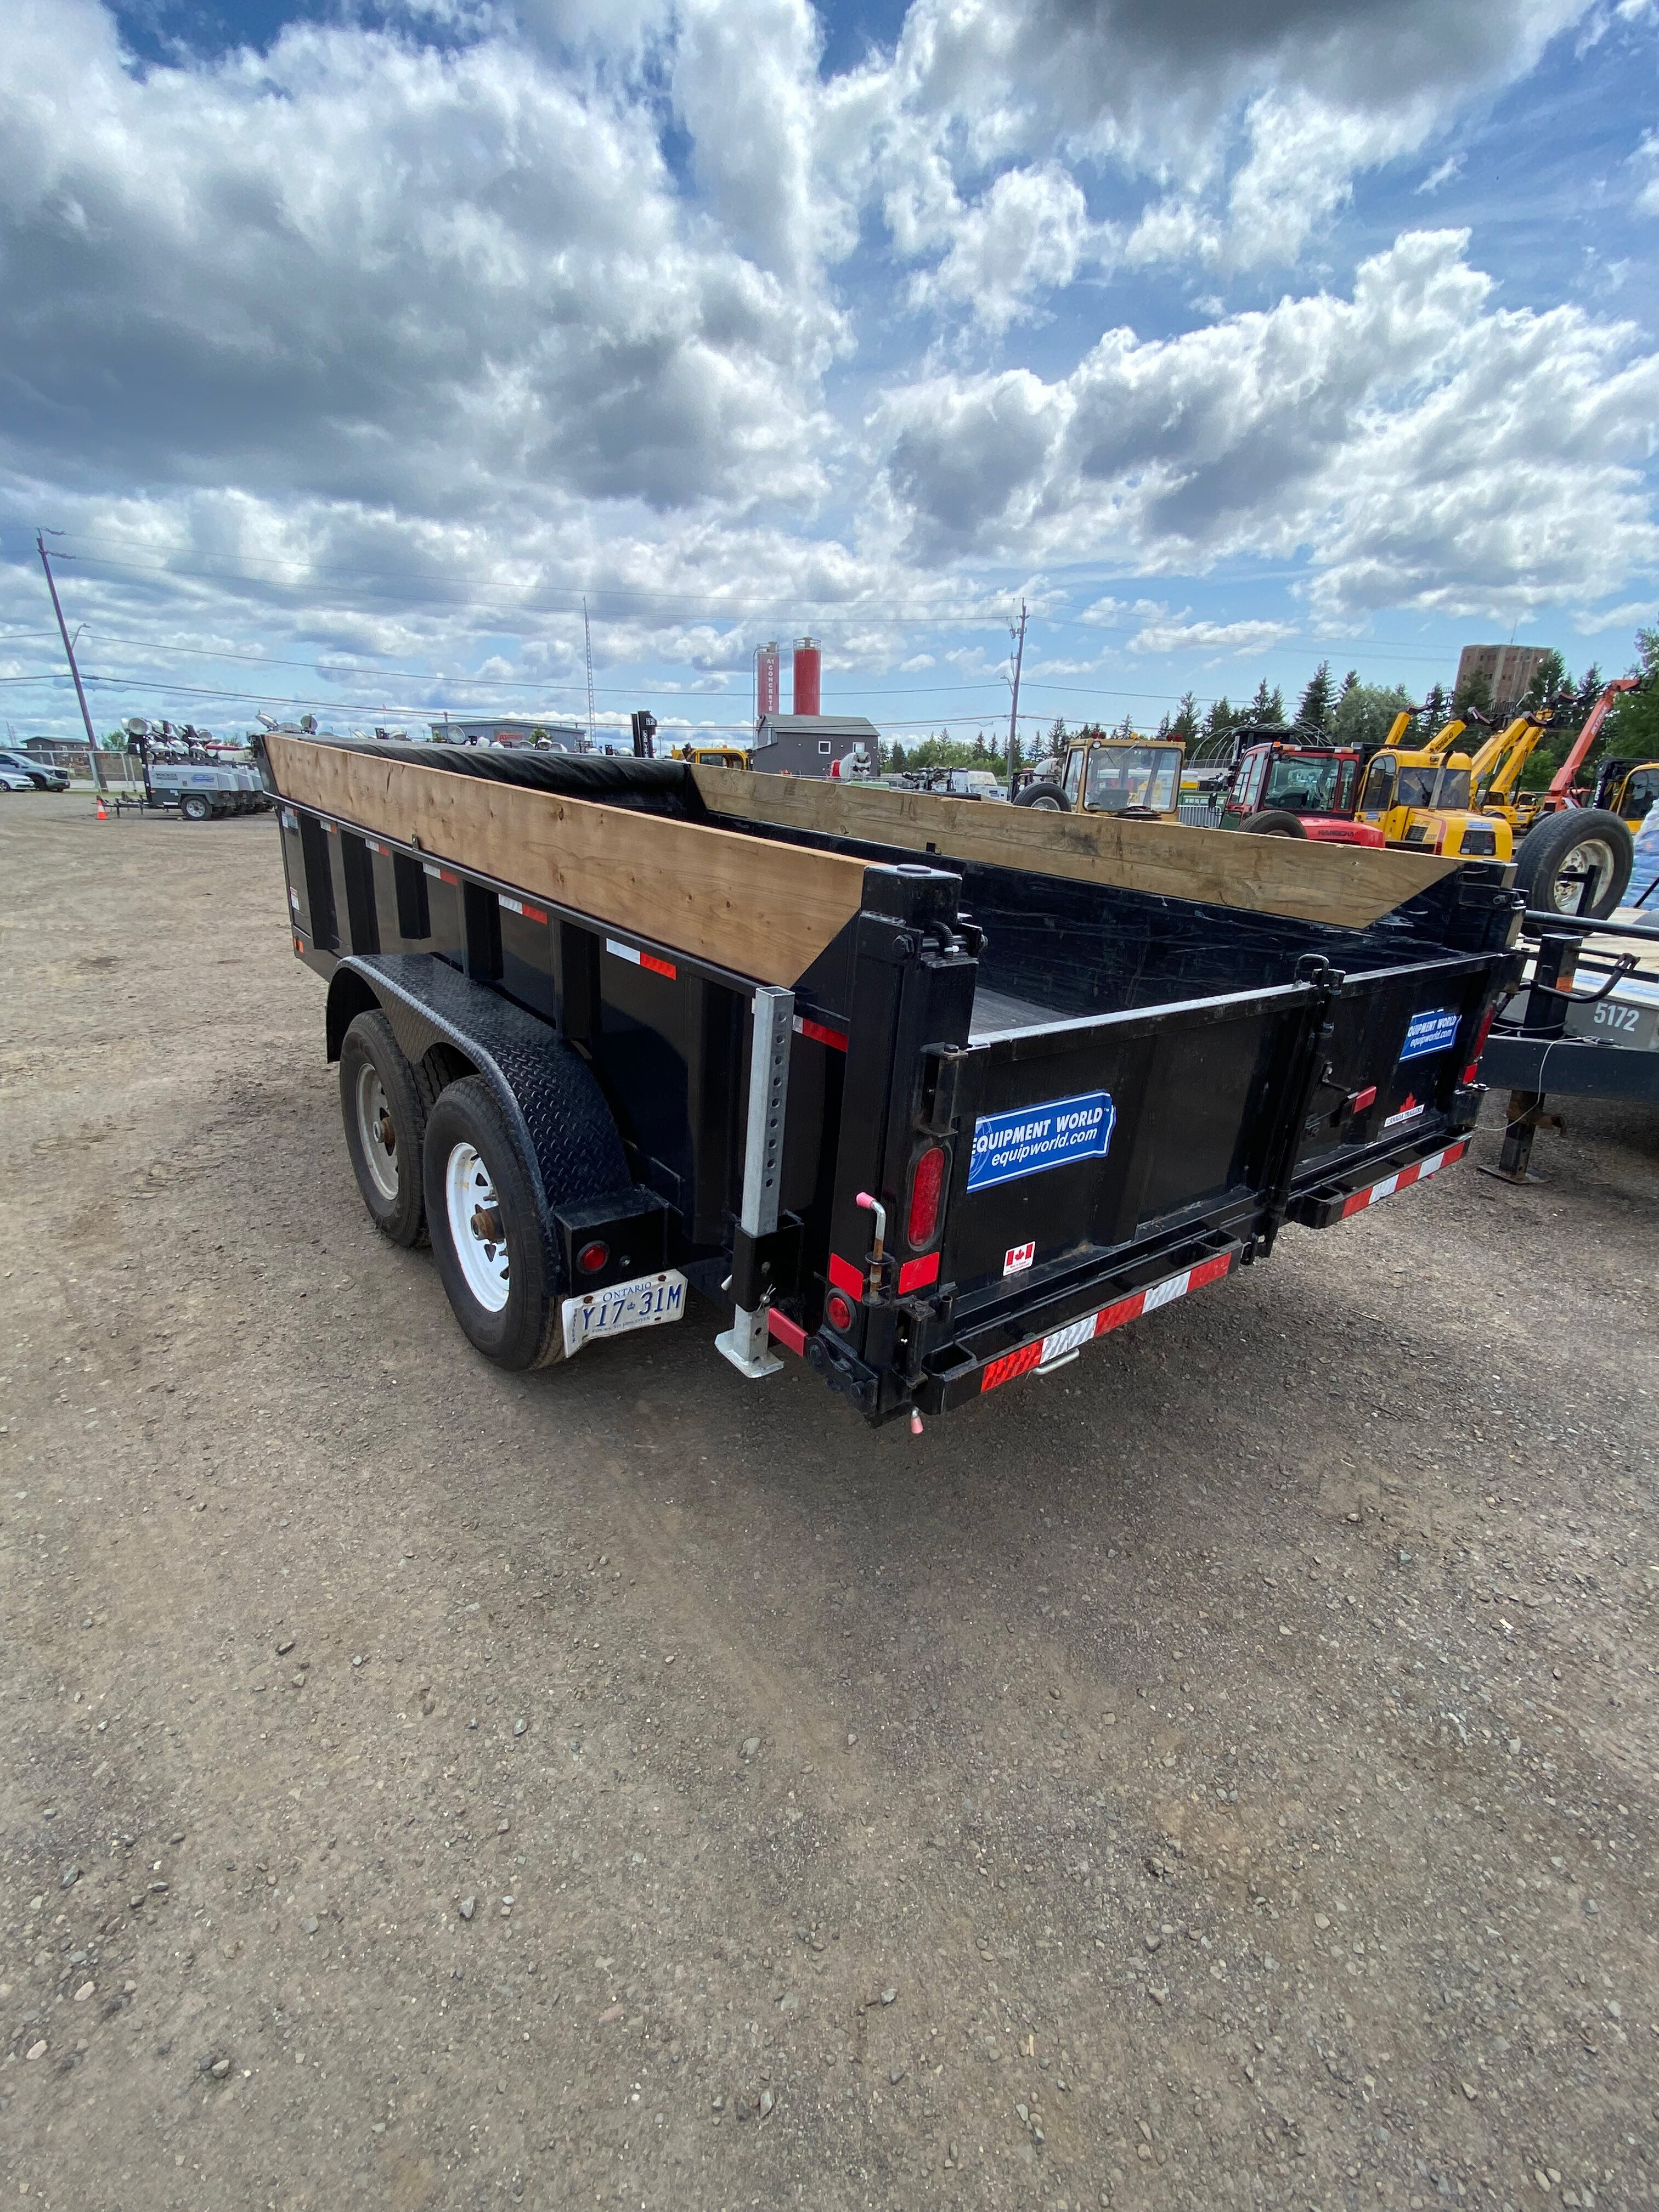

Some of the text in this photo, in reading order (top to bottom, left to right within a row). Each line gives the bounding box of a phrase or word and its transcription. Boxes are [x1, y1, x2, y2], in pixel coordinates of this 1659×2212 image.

[1408, 1015, 1457, 1037] QUIPMENT WORLD
[1594, 1002, 1640, 1032] 5172
[1410, 1029, 1452, 1047] equipworld.com
[1056, 1107, 1103, 1132] WORLD
[991, 1128, 1098, 1167] equipworld.com
[603, 1281, 652, 1302] ONTARIO
[583, 1284, 682, 1330] Y17 31M
